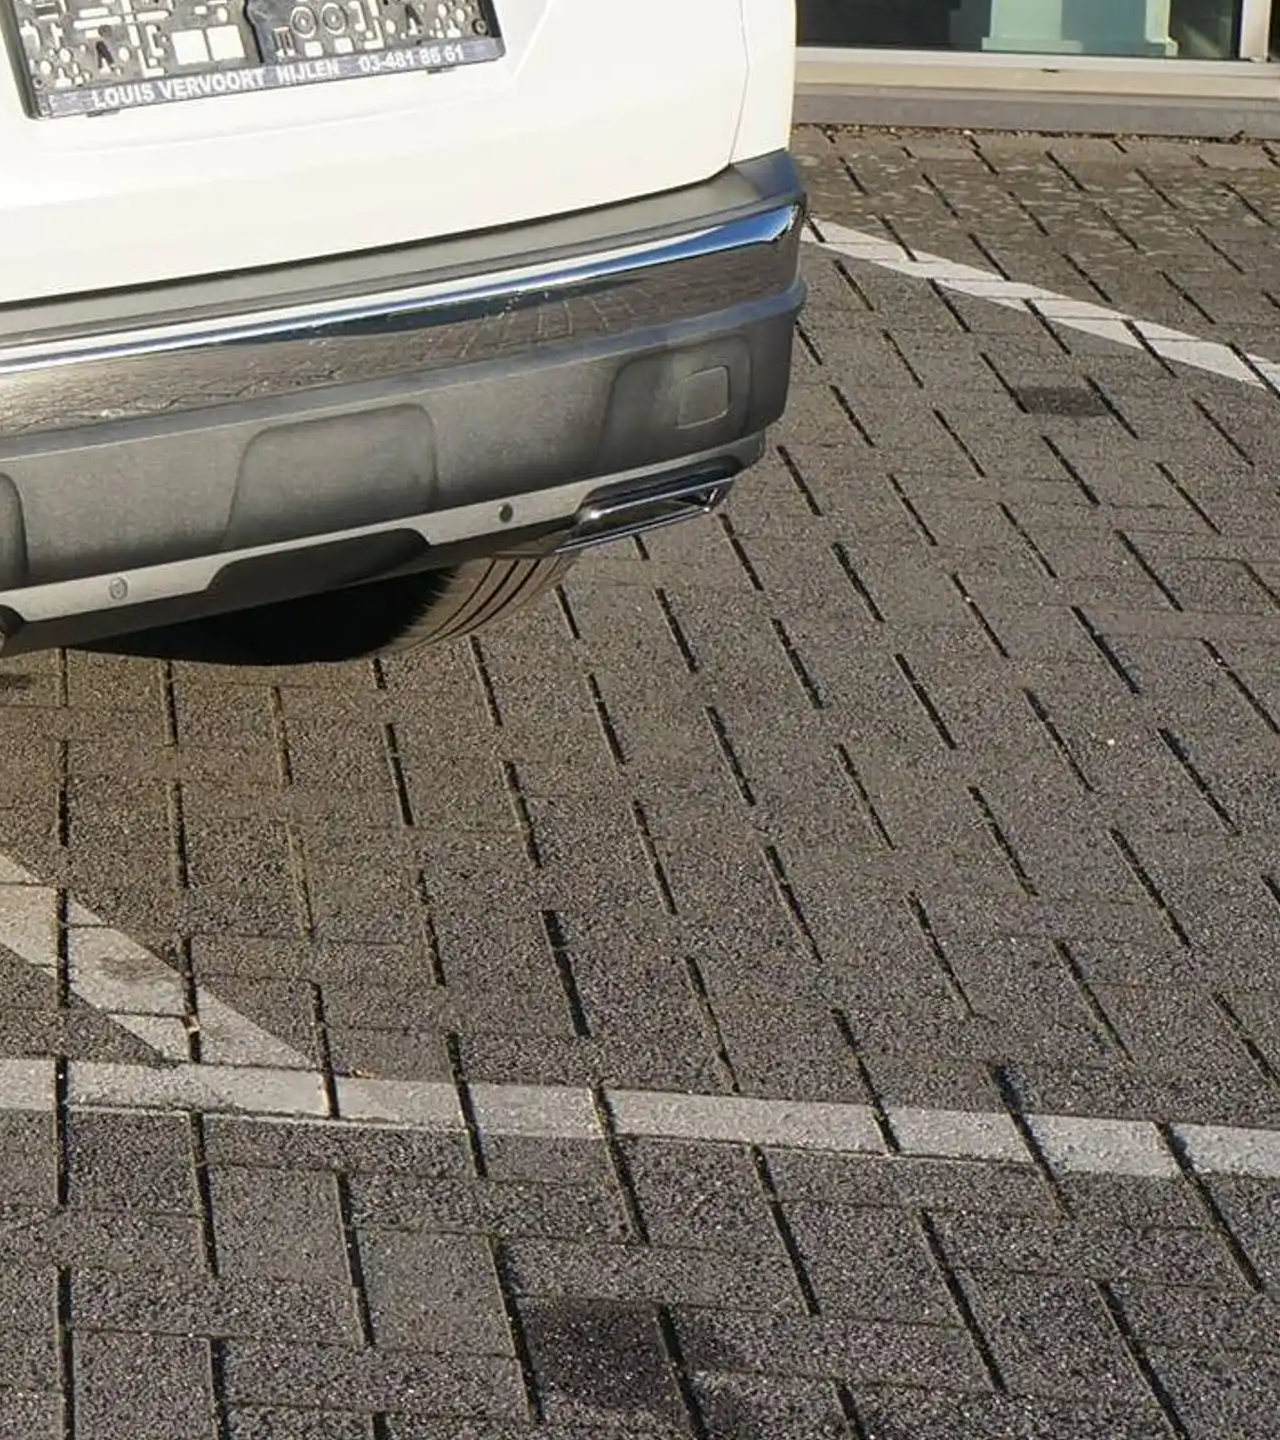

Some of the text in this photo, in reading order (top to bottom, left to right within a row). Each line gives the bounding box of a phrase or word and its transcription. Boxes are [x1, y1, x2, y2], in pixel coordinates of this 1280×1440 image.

[91, 83, 157, 110] LOUIS
[158, 67, 266, 101] VERVOORT
[276, 60, 340, 85] NIJLEN
